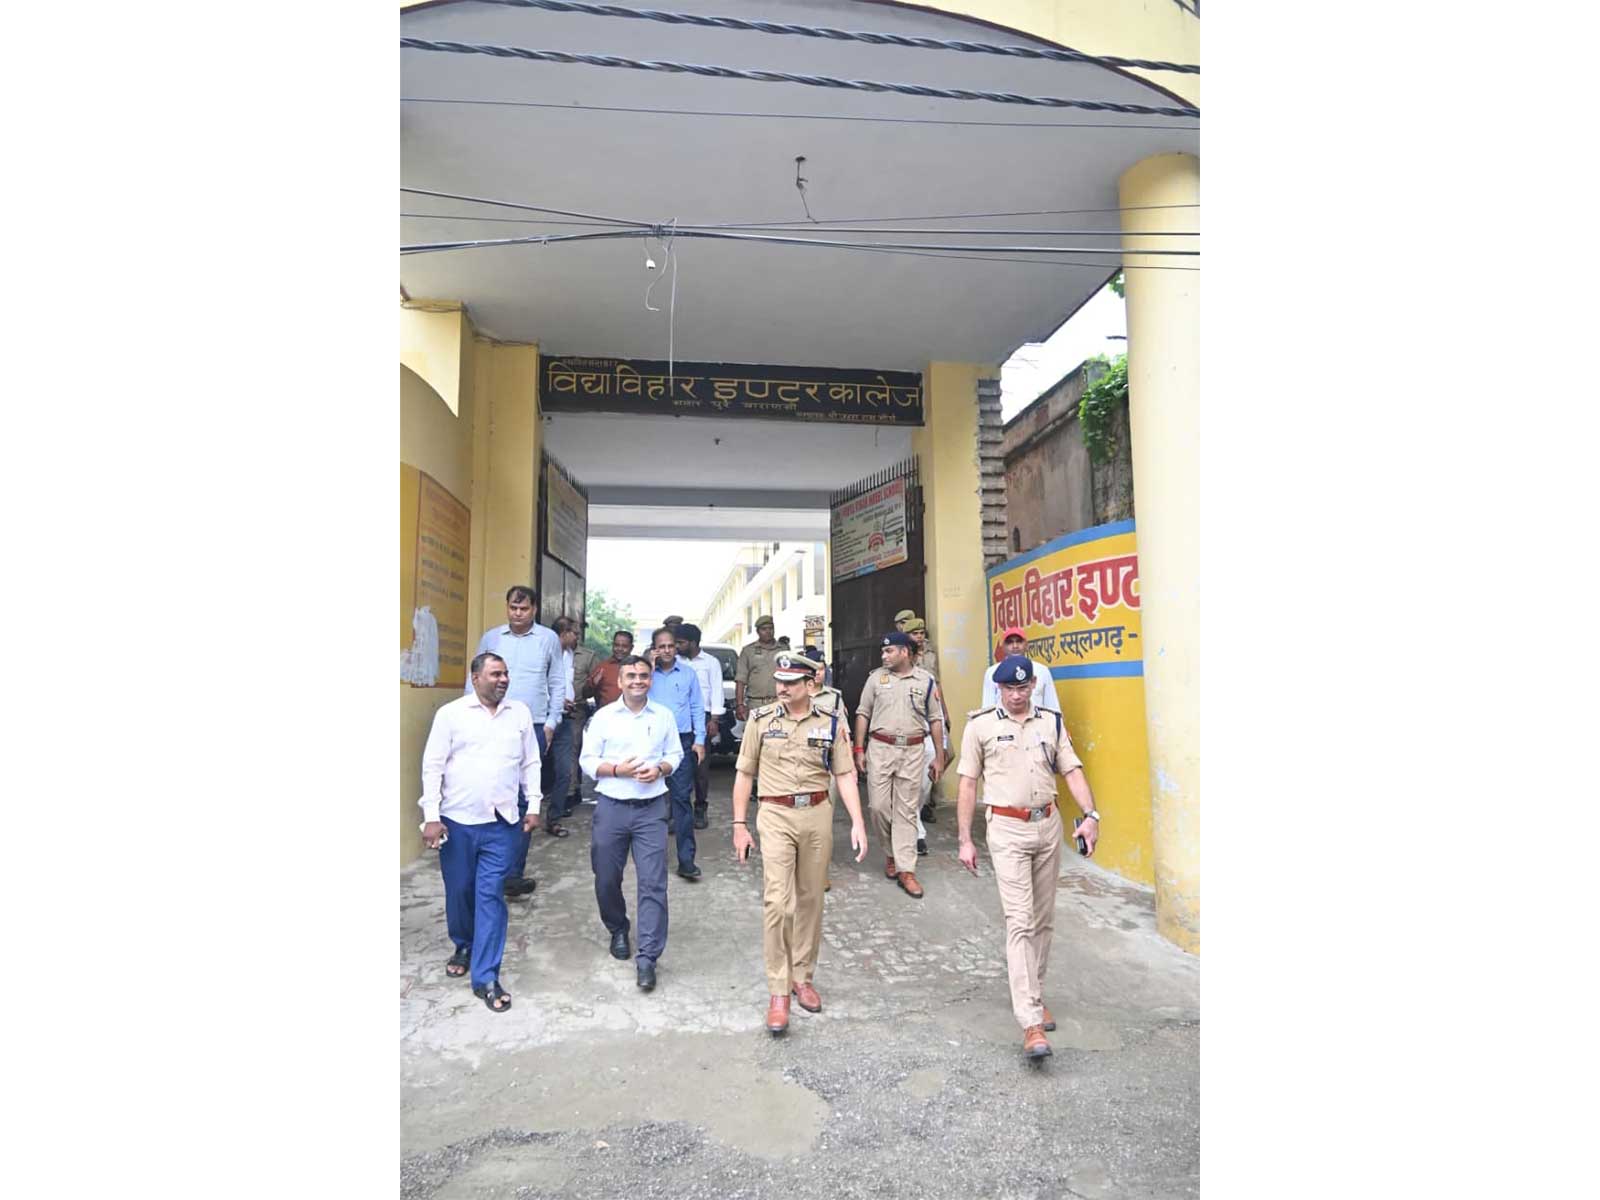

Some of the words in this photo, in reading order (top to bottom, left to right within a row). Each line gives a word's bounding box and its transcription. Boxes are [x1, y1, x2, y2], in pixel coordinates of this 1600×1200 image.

[547, 361, 611, 394] विद्या
[613, 364, 705, 400] विहार
[709, 378, 826, 402] इण्टर
[827, 375, 921, 407] कालेज
[992, 581, 1024, 634] विद्या
[1024, 567, 1075, 627] विहार
[1077, 554, 1141, 622] इण्ट
[1026, 635, 1060, 663] लारपुर,
[1060, 626, 1125, 659] रसूलगढ़
